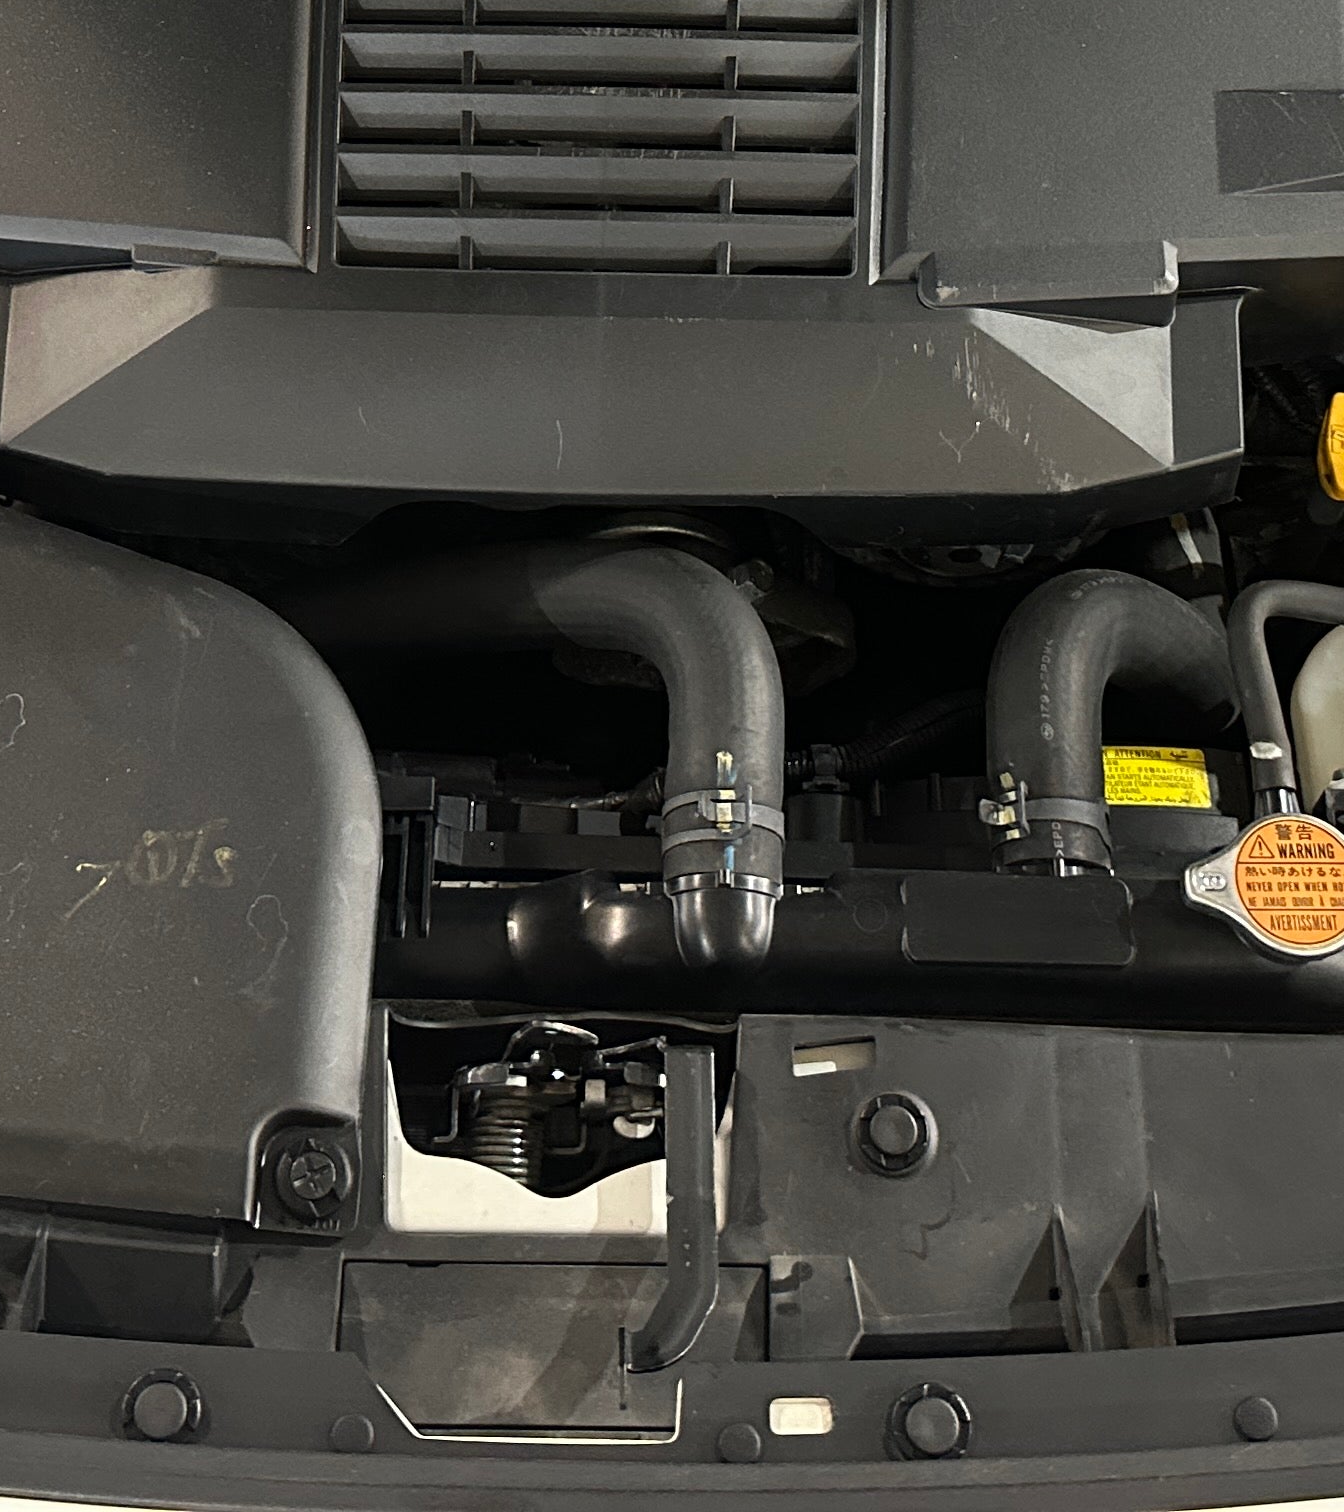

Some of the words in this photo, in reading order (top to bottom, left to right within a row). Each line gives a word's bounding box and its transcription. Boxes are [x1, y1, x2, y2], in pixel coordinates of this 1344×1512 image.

[1052, 821, 1065, 857] >EPD
[1274, 823, 1313, 841] 警告
[1276, 842, 1336, 860] WARNING
[1246, 881, 1273, 892] NEVER
[1277, 881, 1300, 892] OPEN
[1304, 881, 1328, 892] WHEN
[1269, 914, 1338, 931] AVERTISSMENT
